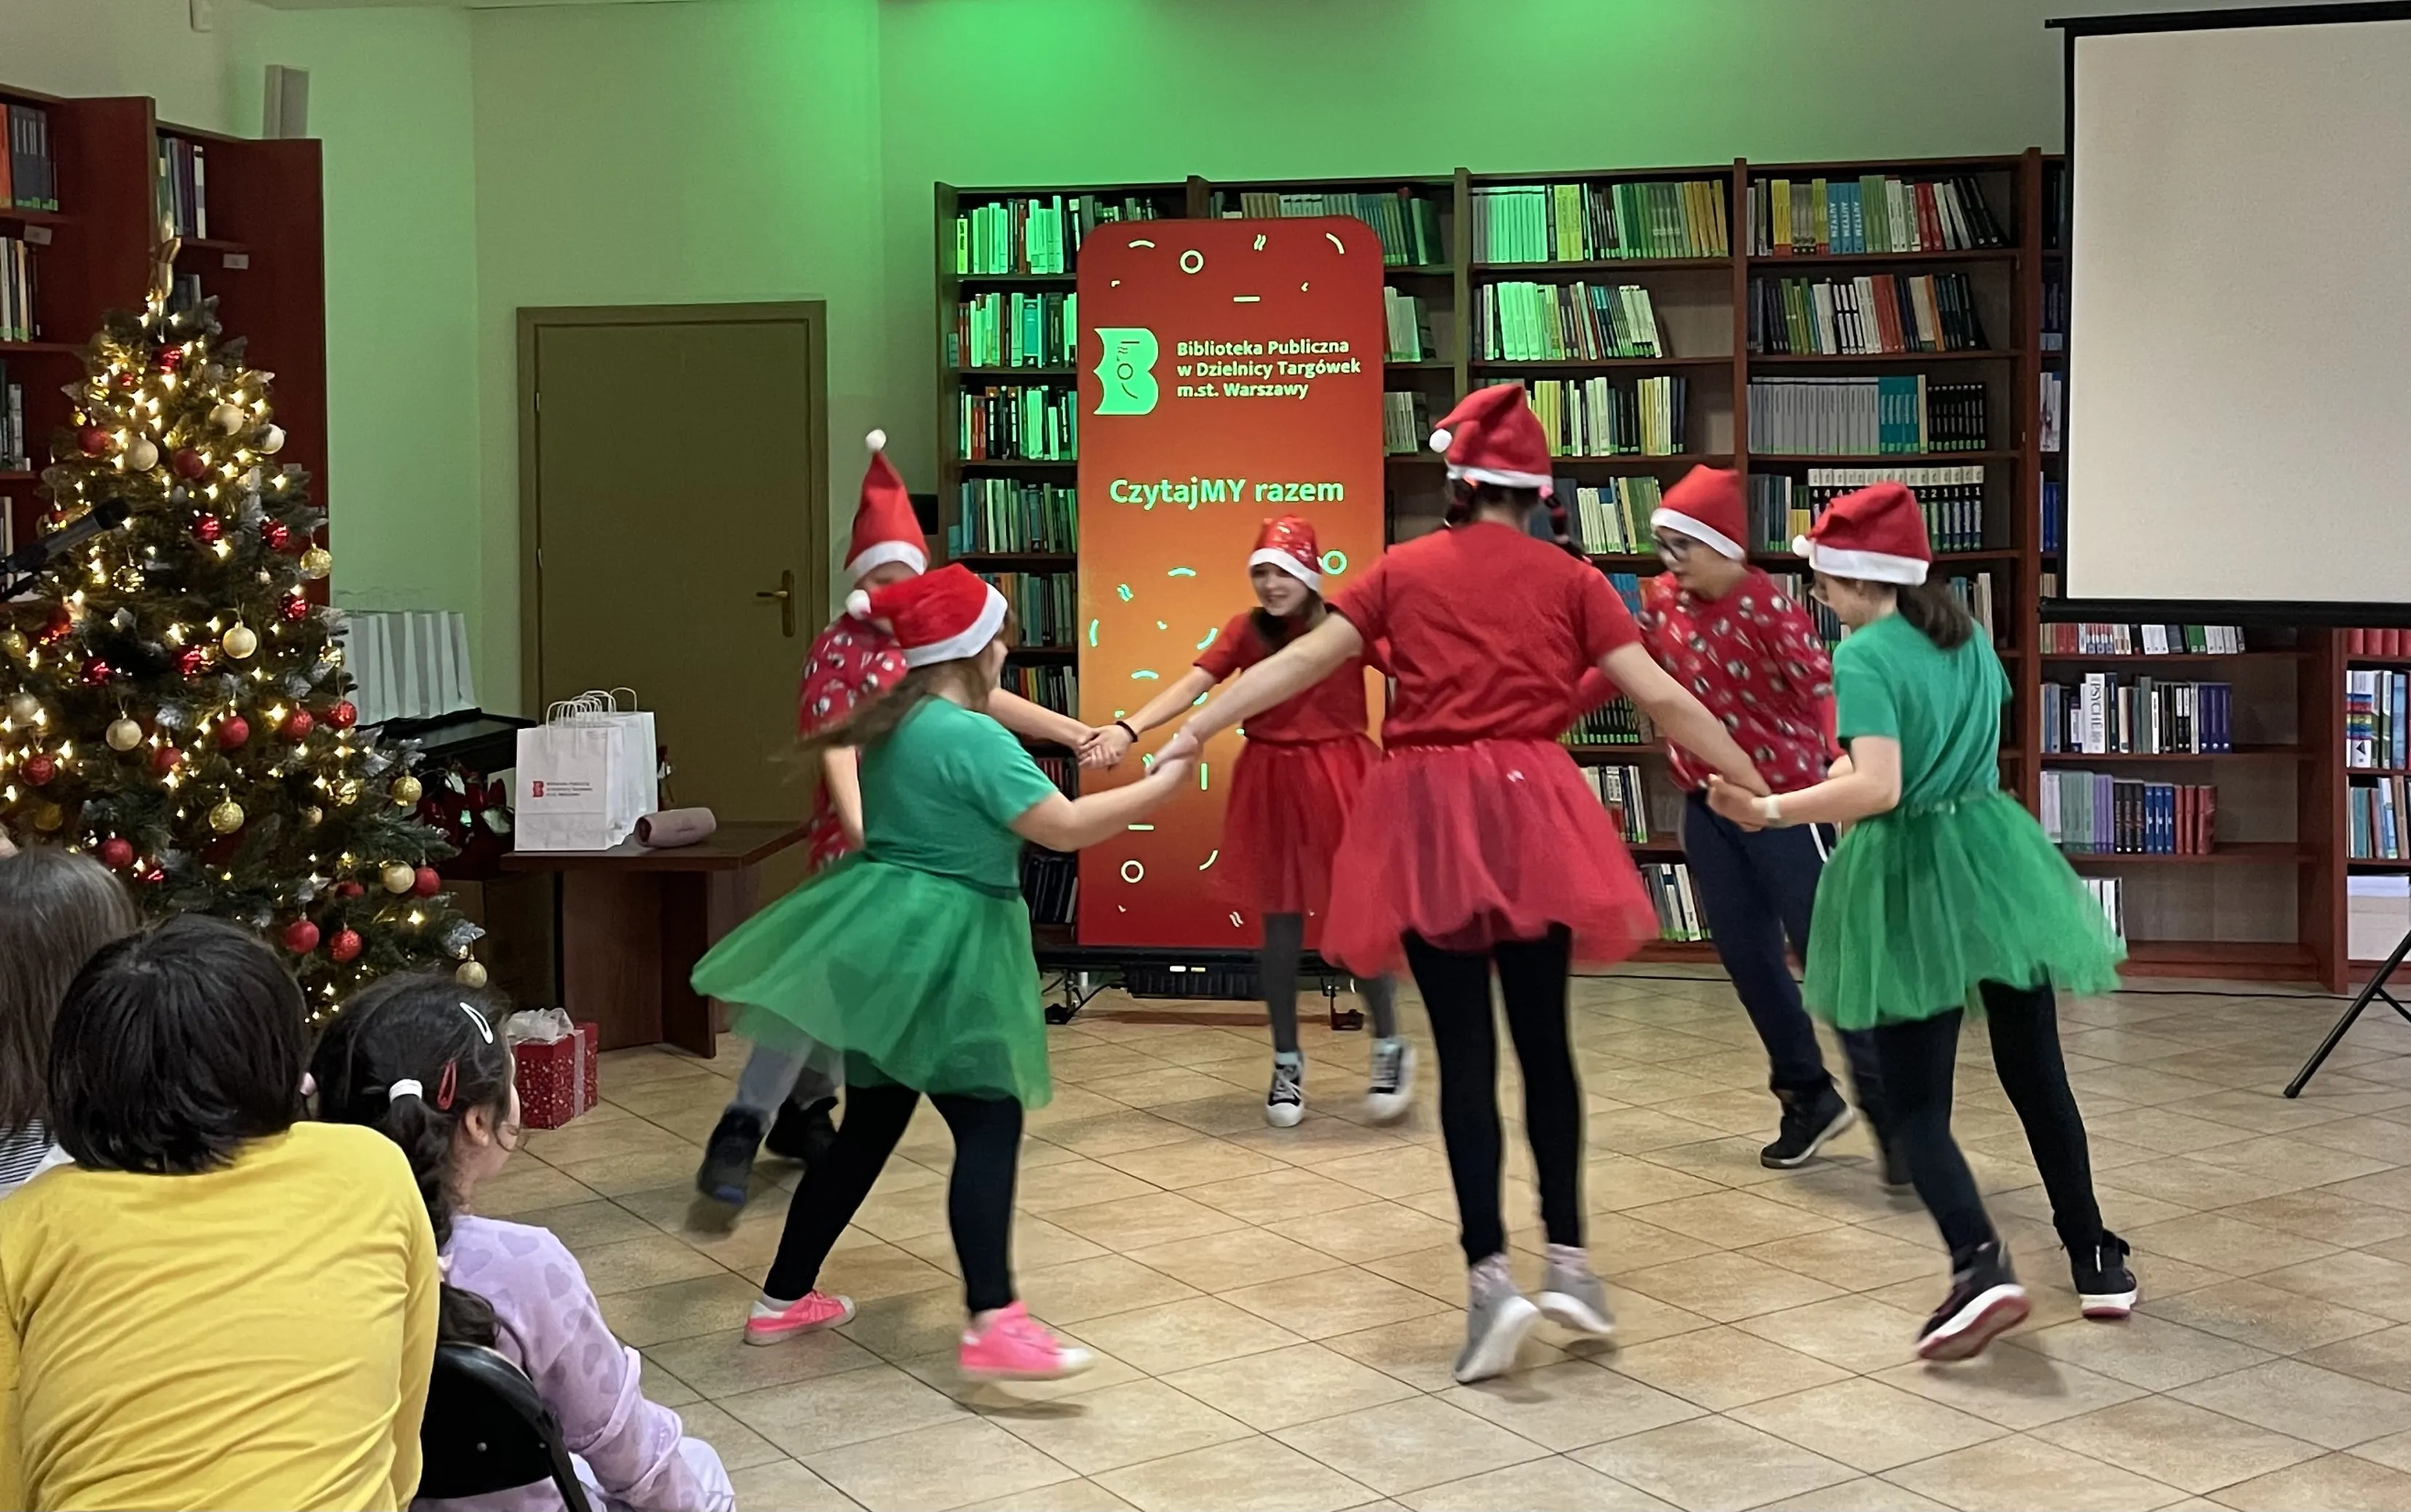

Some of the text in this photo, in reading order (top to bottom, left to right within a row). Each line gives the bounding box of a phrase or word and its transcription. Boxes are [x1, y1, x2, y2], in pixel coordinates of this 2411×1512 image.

[1176, 339, 1350, 357] Biblioteka Publiczna
[1176, 357, 1361, 380] w Dzielnicy Targówek
[1176, 382, 1309, 400] m.st. Warszawy
[1109, 475, 1345, 510] CzytajMY razem
